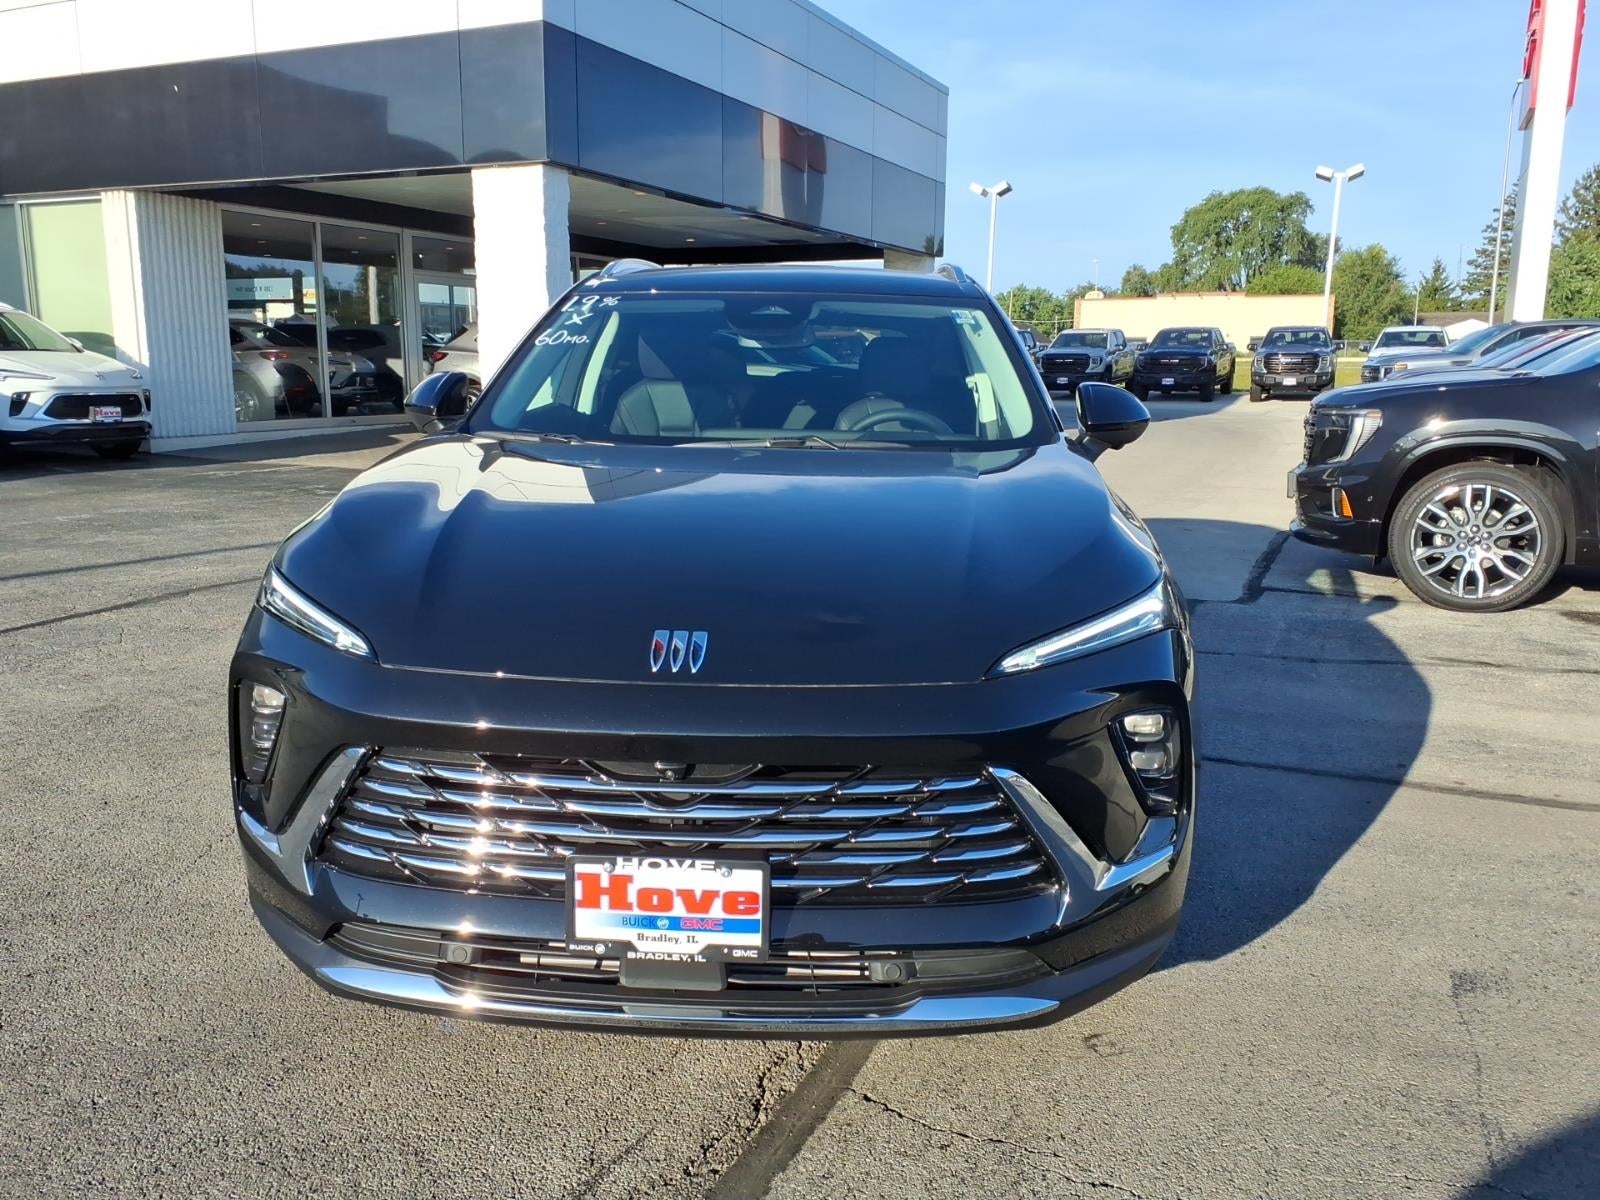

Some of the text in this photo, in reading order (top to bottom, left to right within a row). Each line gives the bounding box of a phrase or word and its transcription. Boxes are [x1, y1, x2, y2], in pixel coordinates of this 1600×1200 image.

[616, 857, 716, 871] HOVE
[577, 873, 760, 915] Hove
[622, 917, 724, 930] BUICK GMC
[637, 933, 699, 945] Bradley, IL
[627, 951, 707, 962] BRADLEY, IL
[732, 949, 759, 958] GMC
